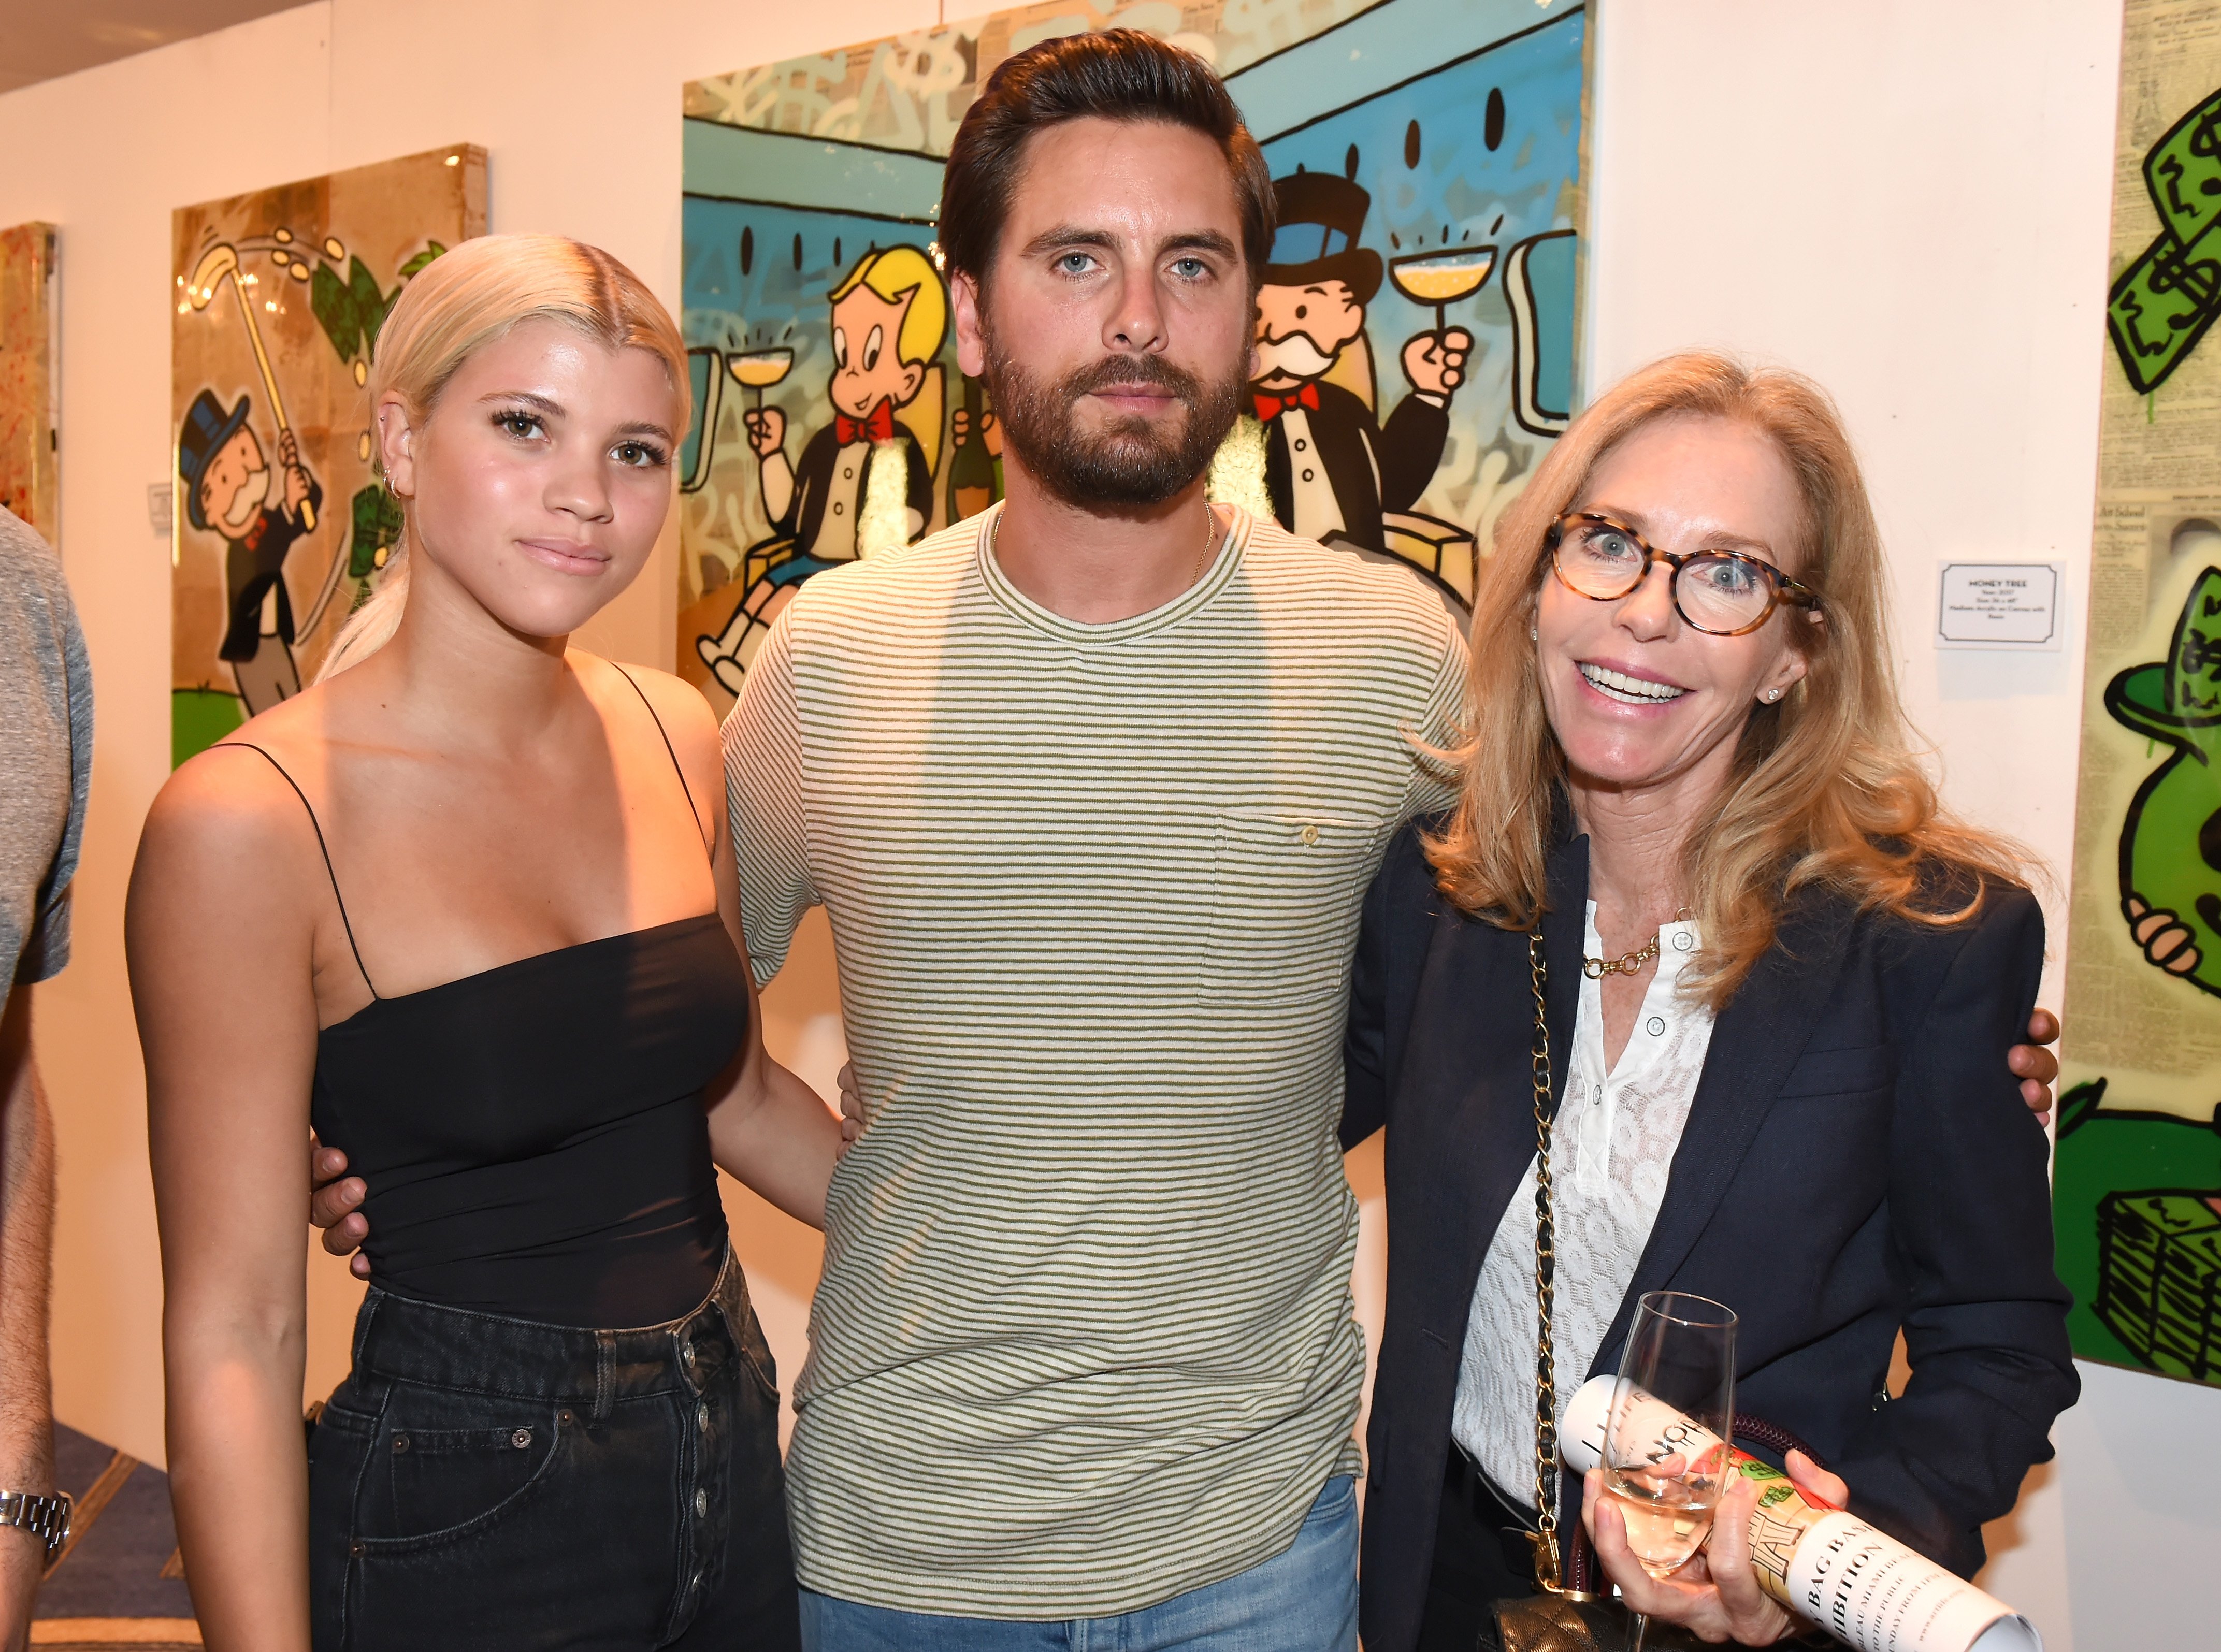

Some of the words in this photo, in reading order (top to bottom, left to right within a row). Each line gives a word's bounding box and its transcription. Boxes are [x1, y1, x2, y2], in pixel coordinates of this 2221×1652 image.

[1808, 1556, 1831, 1610] BAG
[1860, 1569, 1885, 1608] MIAMI
[1873, 1612, 1884, 1634] THE
[1880, 1574, 1905, 1611] PUBLIC
